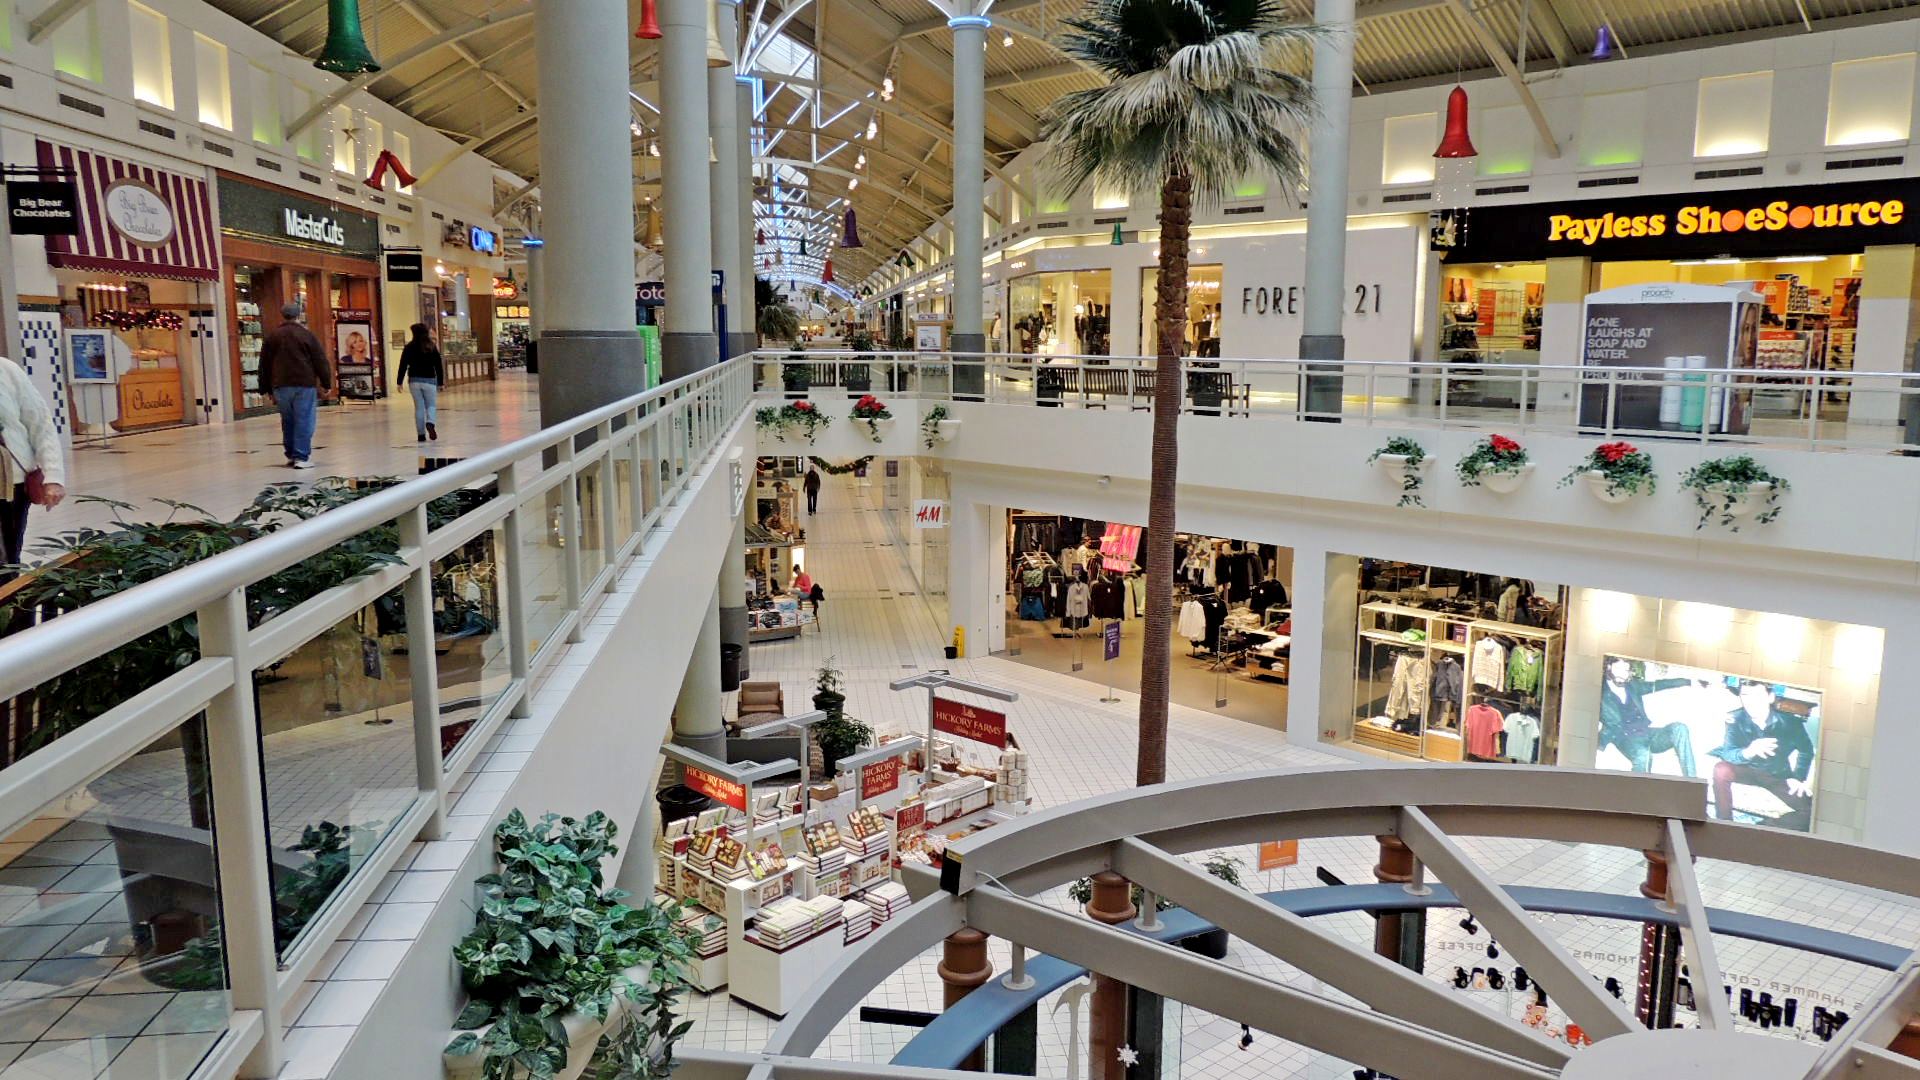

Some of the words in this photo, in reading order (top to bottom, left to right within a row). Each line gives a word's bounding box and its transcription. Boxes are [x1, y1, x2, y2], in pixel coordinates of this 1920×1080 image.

[19, 198, 37, 208] Big
[38, 199, 62, 207] Bear
[13, 208, 72, 218] Chocolates
[285, 208, 345, 246] MasterCuts
[1548, 212, 1666, 246] Payless
[1676, 200, 1904, 235] ShoeSource
[1354, 284, 1381, 314] 21
[1588, 317, 1620, 328] ACNE
[1587, 328, 1636, 338] LAUGHS
[1637, 328, 1653, 338] AT
[1587, 338, 1619, 349] SOAP
[1621, 338, 1647, 348] AND
[1586, 349, 1630, 359] WATER.
[132, 388, 174, 411] Chocolate
[936, 711, 973, 729] HICKORY
[973, 720, 1002, 736] FARMS
[863, 760, 897, 778] HICKORY
[866, 770, 892, 786] FARMS
[718, 778, 744, 797] FARMS
